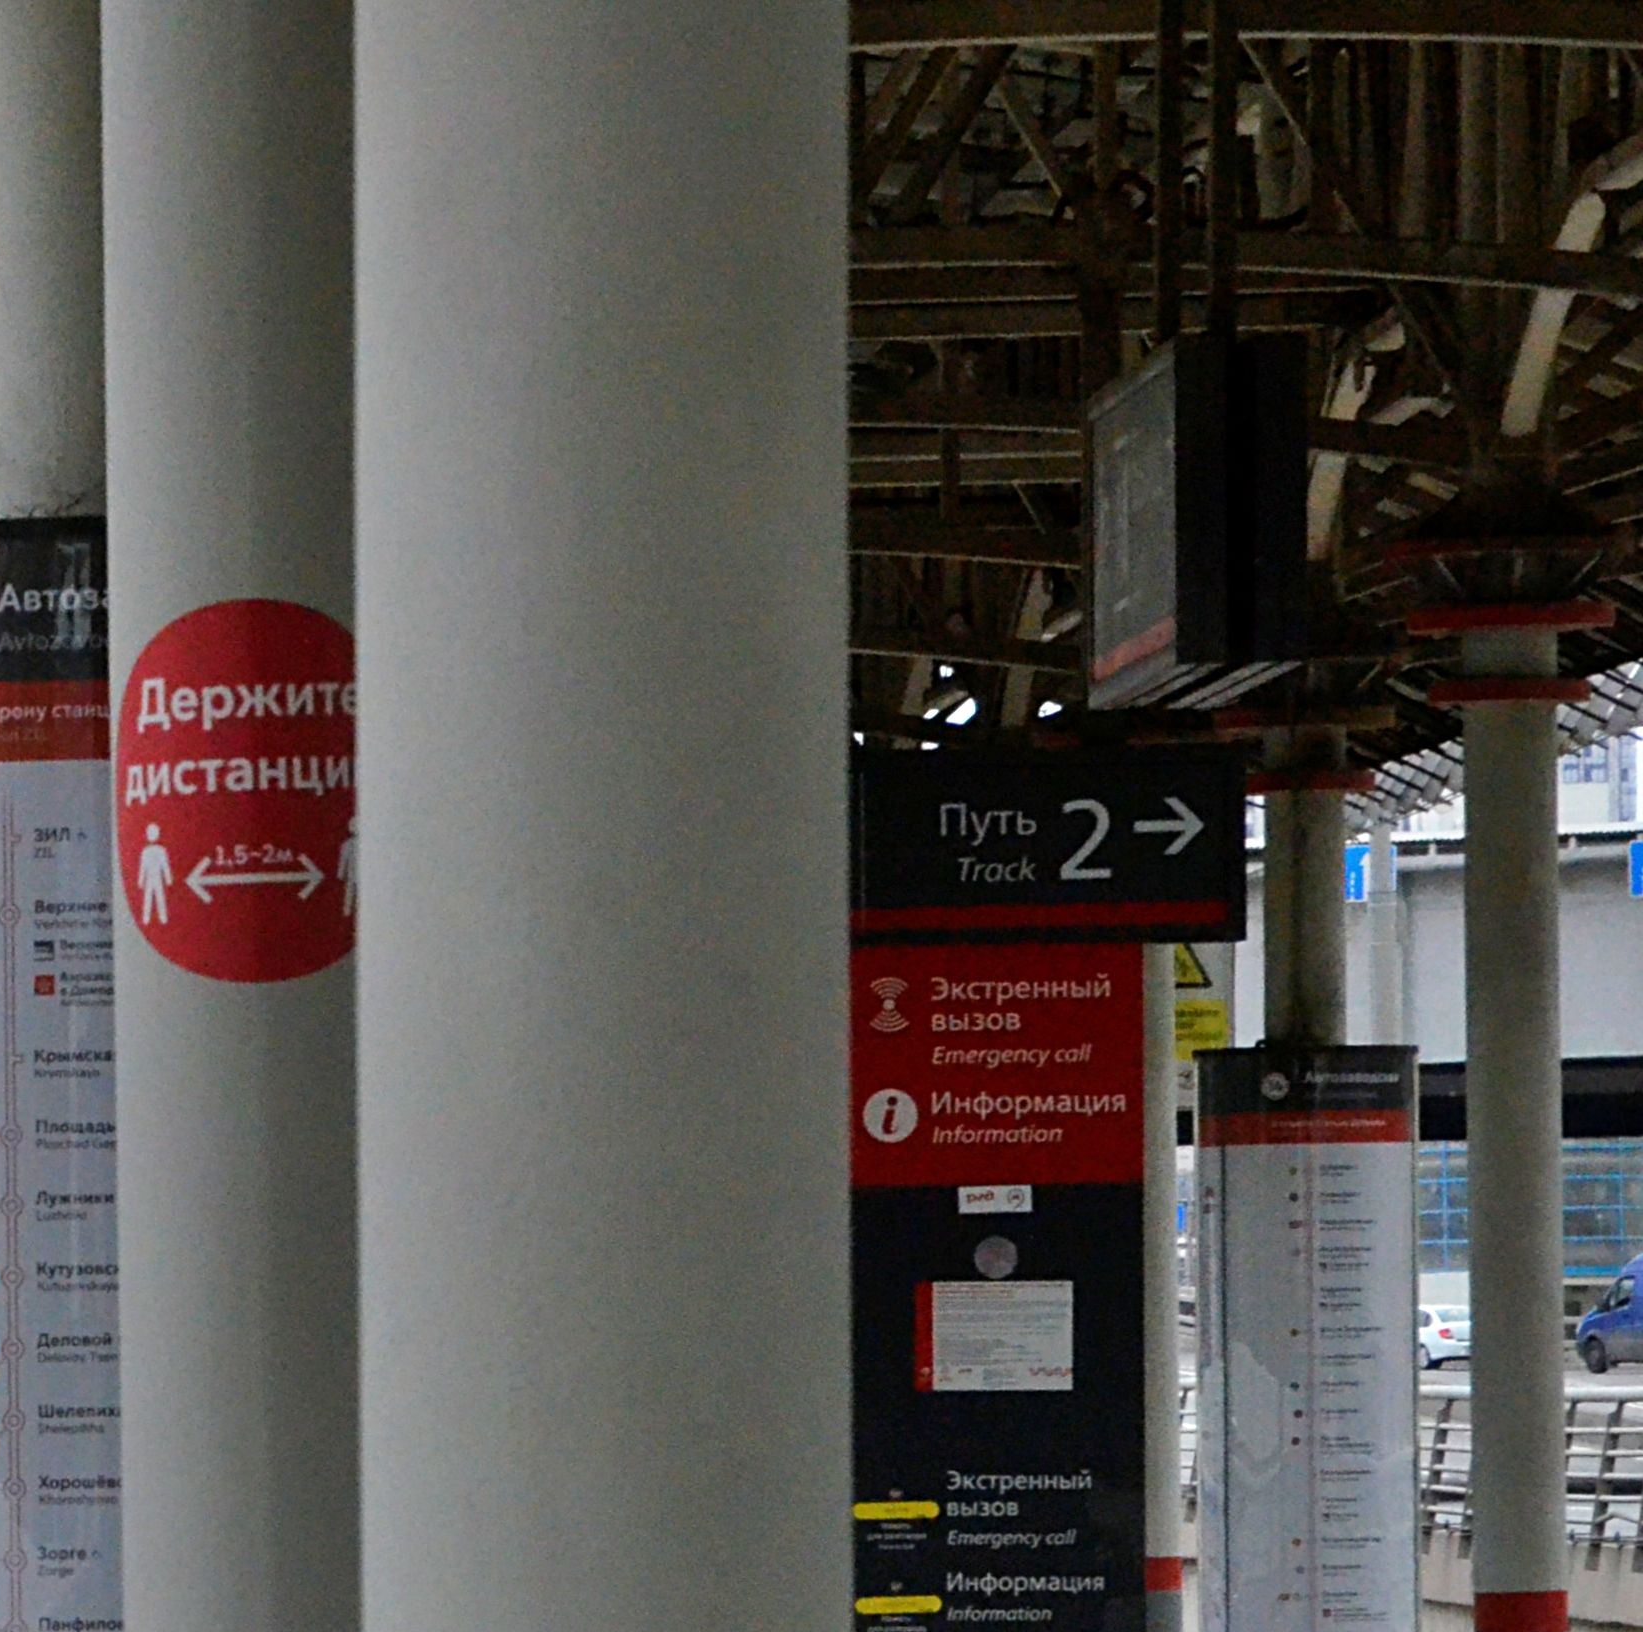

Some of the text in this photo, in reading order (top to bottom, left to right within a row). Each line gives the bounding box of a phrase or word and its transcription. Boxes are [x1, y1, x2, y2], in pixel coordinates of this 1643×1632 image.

[125, 754, 356, 807] дистанци
[33, 827, 71, 843] ЗИЛ
[940, 798, 1113, 881] Путь 2
[958, 855, 1036, 883] Track
[34, 900, 109, 916] Верхние
[930, 972, 1112, 1006] Экстренный
[930, 1012, 1022, 1033] вызов
[931, 1043, 1093, 1068] Emergency call
[930, 1090, 1127, 1120] Информация
[35, 1118, 115, 1136] Площадь
[932, 1124, 1064, 1145] Information
[36, 1190, 115, 1208] Лужники
[36, 1332, 112, 1349] Деловой
[946, 1469, 1092, 1495] Экстренный
[946, 1501, 1020, 1518] вызов
[947, 1529, 1041, 1549] Emergency
[1045, 1528, 1077, 1546] call
[37, 1545, 87, 1563] Зорге
[946, 1571, 1105, 1597] Информация
[946, 1605, 1053, 1622] Information
